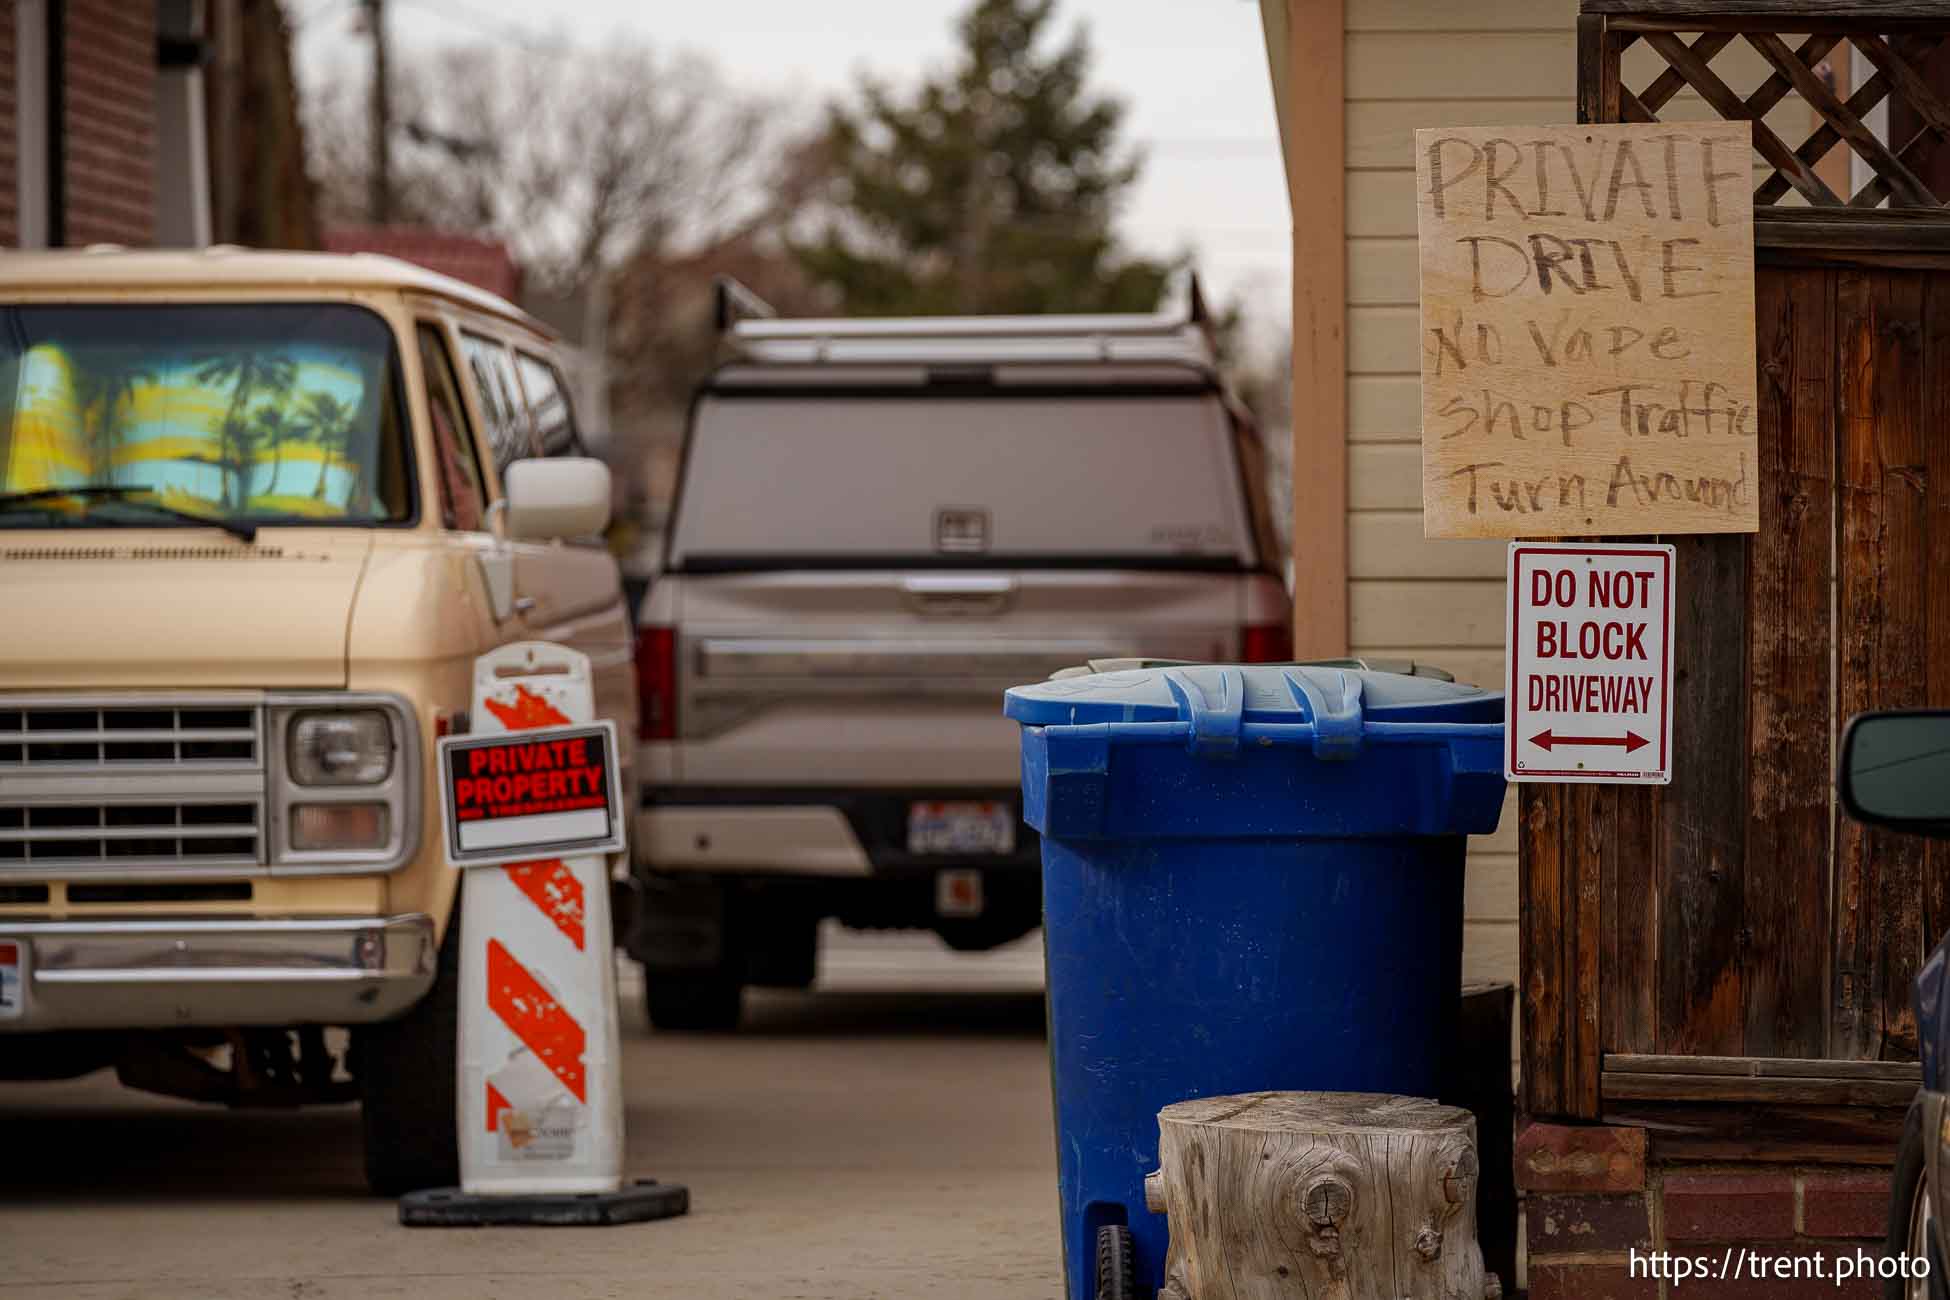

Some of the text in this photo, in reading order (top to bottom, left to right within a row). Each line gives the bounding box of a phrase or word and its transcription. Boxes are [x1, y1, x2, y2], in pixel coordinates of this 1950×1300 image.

[1456, 233, 1721, 304] DRIVE
[1527, 308, 1691, 372] Vape
[1438, 379, 1756, 447] Shop Traffic
[1449, 452, 1750, 514] Turn Around
[1531, 569, 1655, 609] DO NOT
[1536, 620, 1648, 660] BLOCK
[1528, 674, 1654, 714] DRIVEWAY
[469, 738, 588, 775] PRIVATE
[456, 766, 603, 806] PROPERTY
